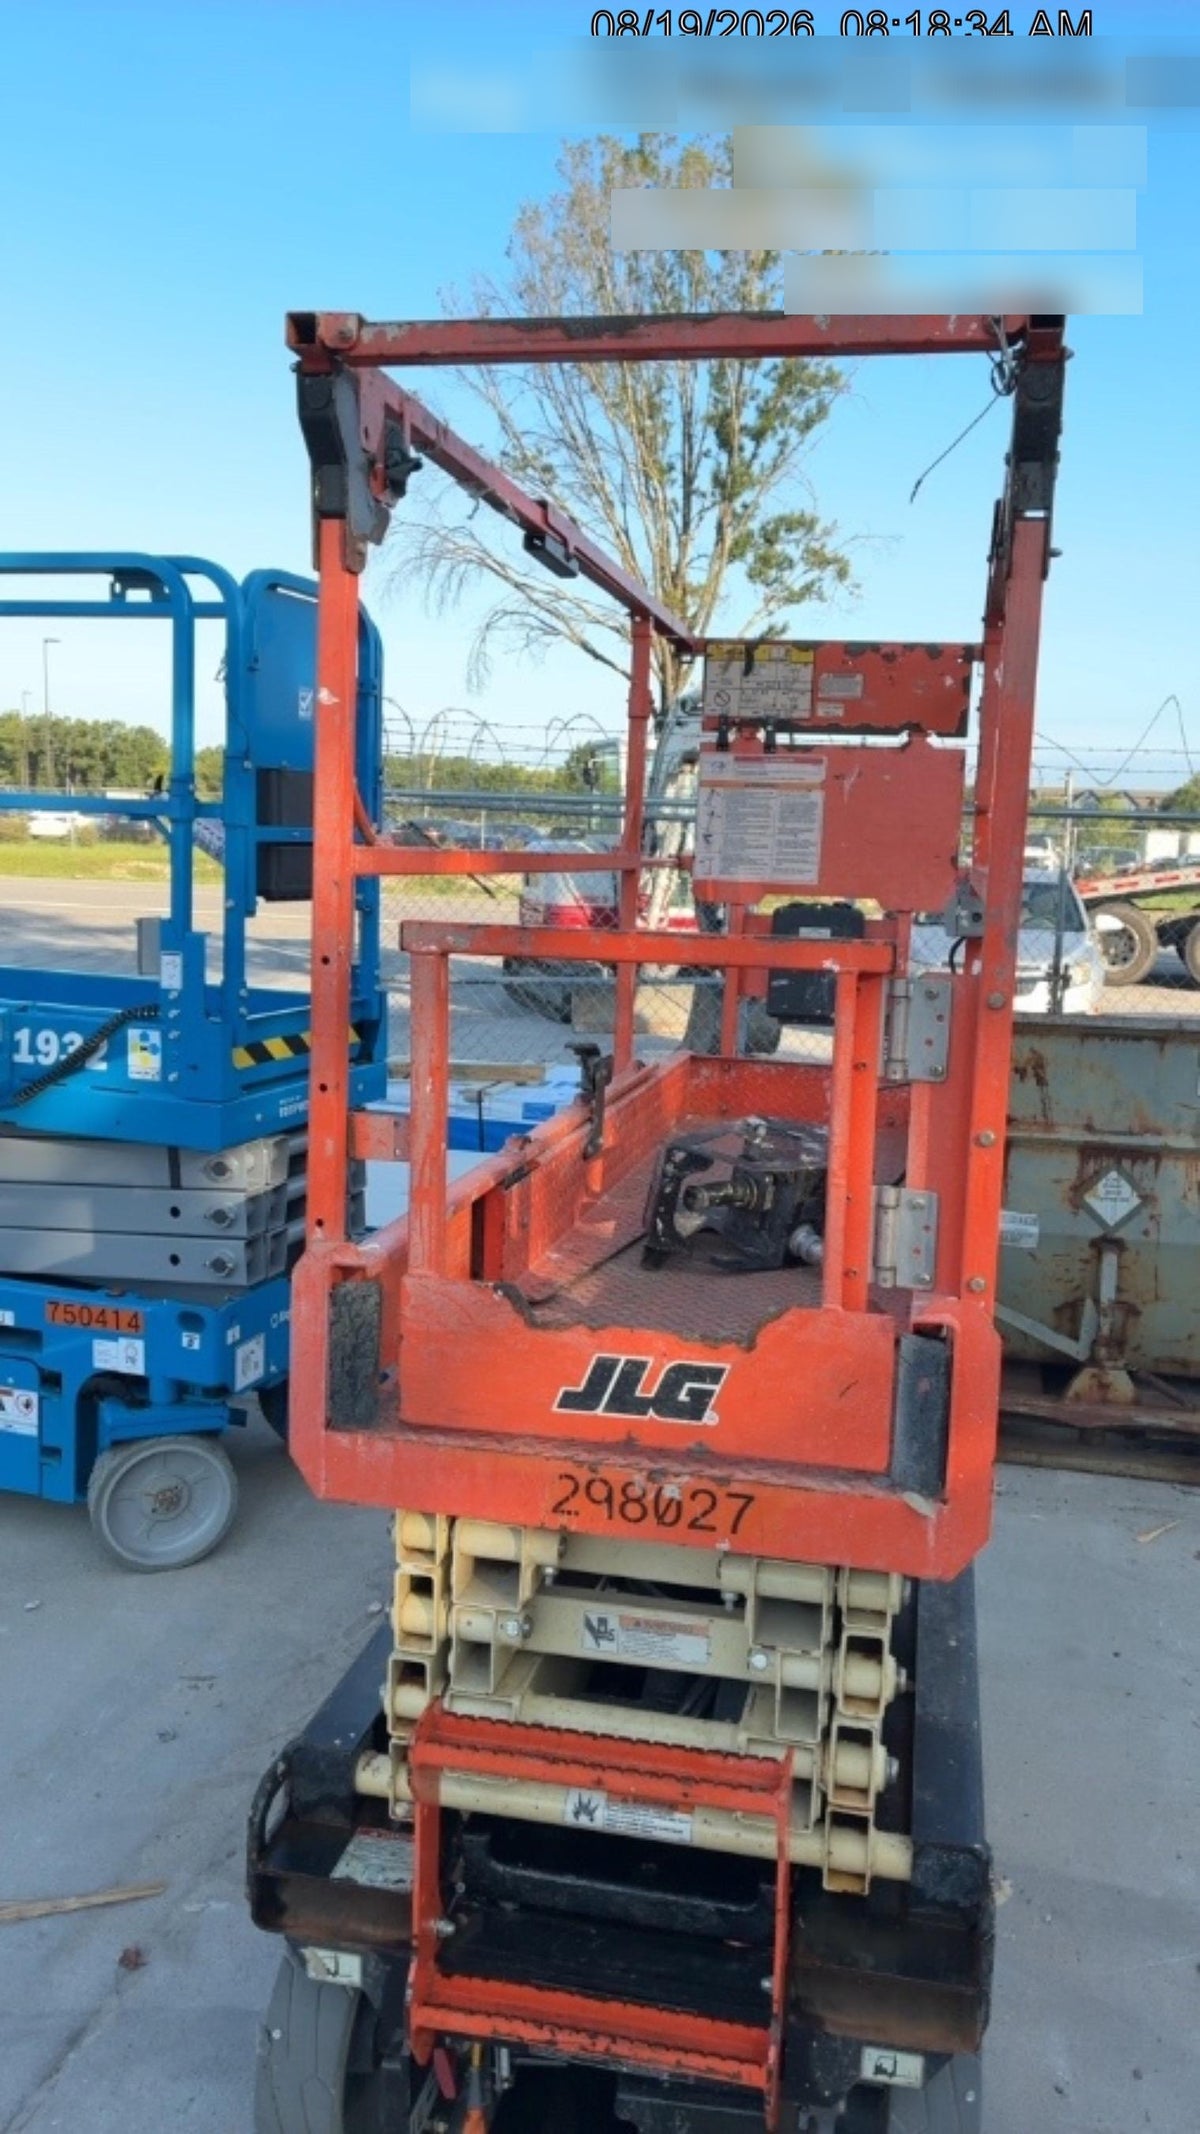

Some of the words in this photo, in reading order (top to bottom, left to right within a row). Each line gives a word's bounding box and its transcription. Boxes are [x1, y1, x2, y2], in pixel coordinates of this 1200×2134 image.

[46, 1301, 142, 1333] 750414
[552, 1353, 731, 1425] JLG
[551, 1474, 756, 1535] 298027
